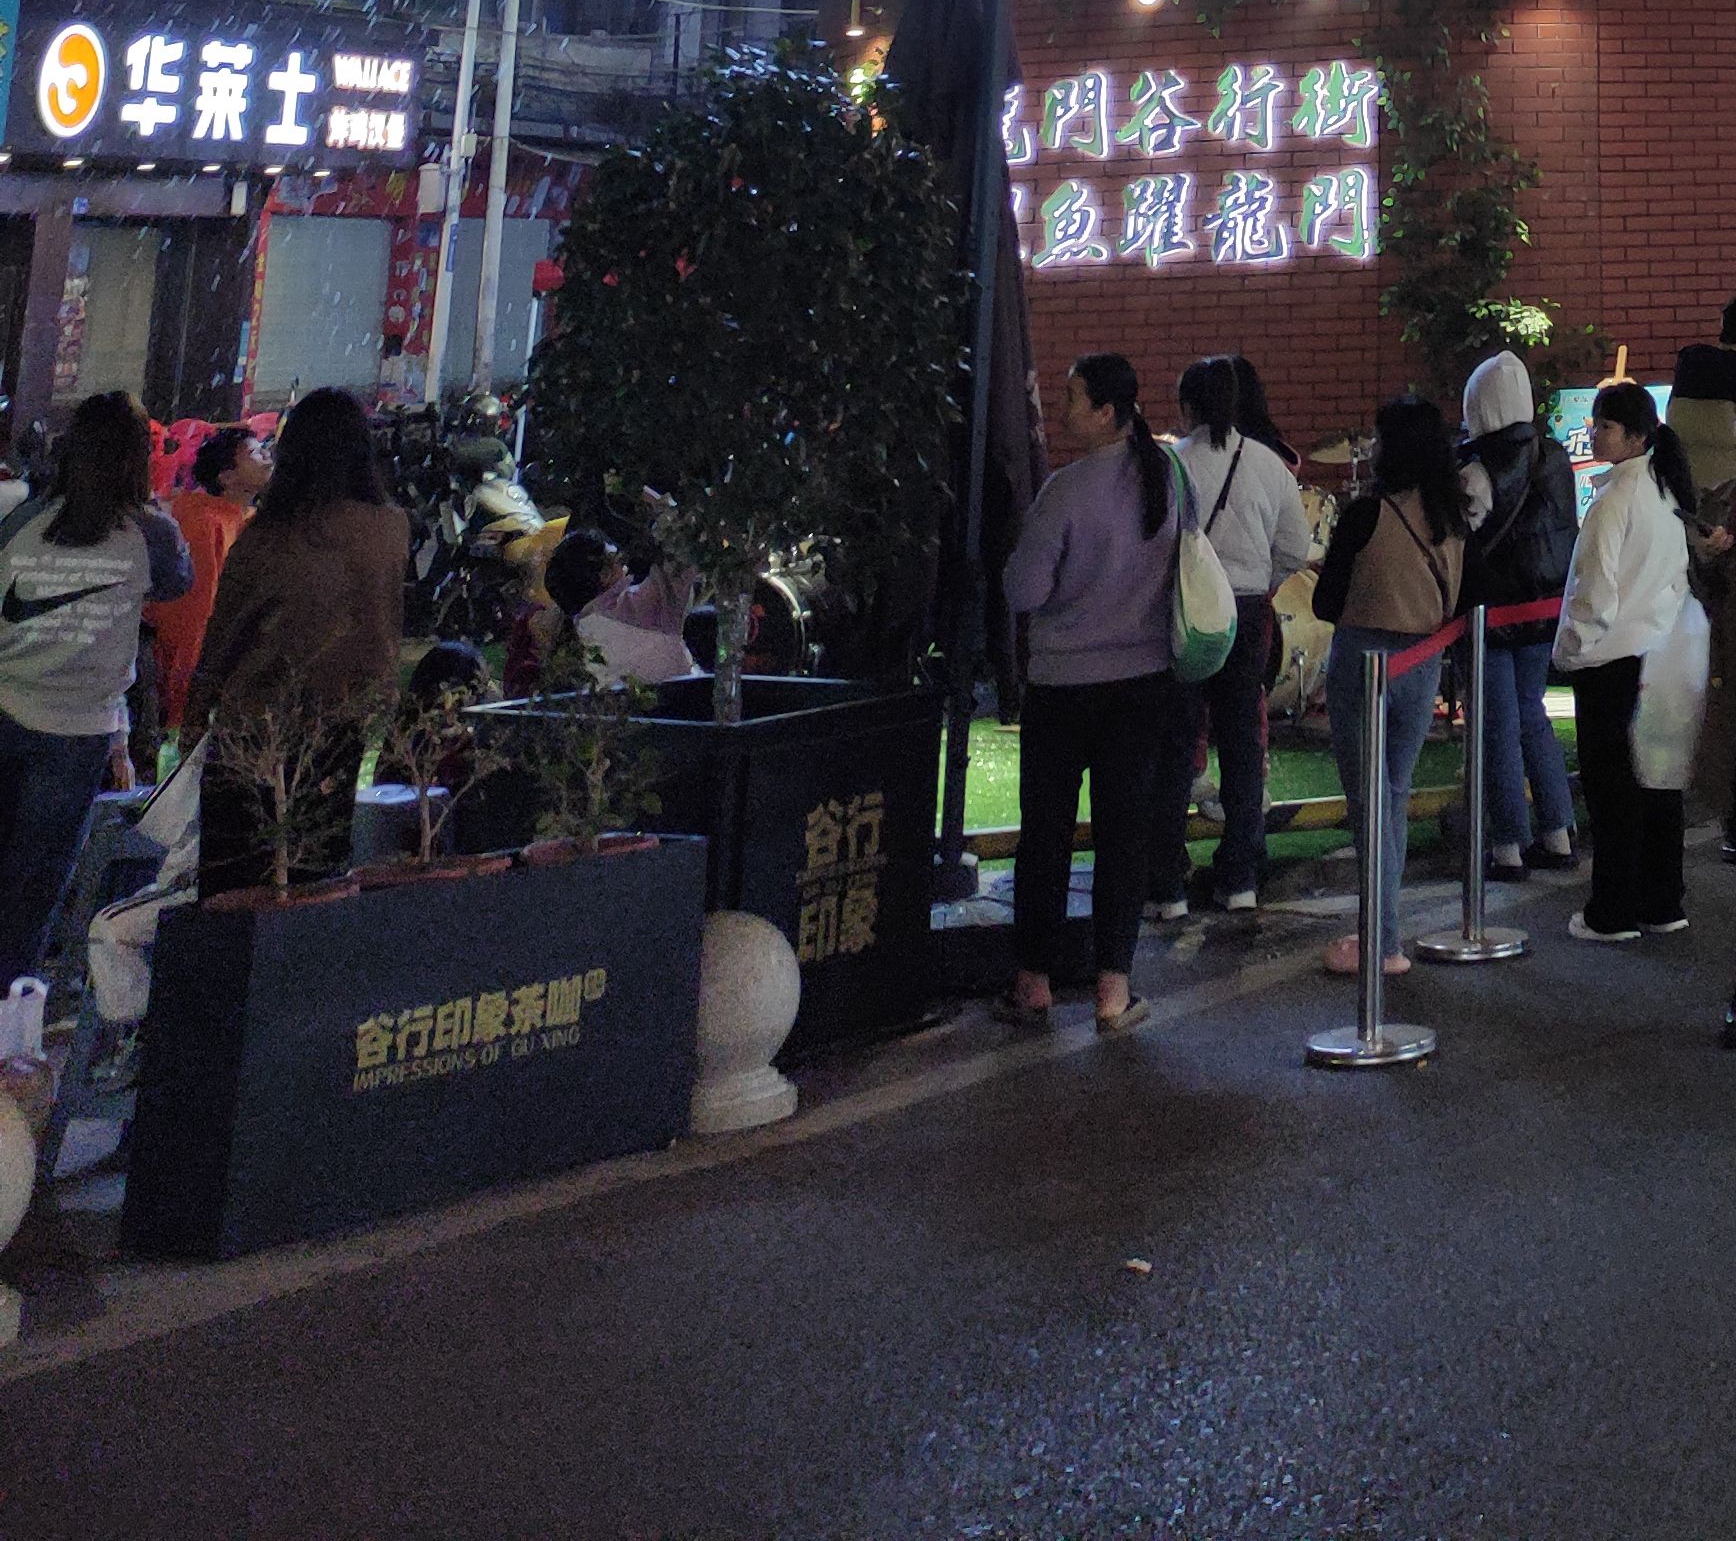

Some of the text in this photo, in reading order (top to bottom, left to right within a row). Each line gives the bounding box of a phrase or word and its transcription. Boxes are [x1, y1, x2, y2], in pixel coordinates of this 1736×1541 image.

[120, 33, 318, 147] 华莱士
[333, 53, 413, 94] WALLACE
[1009, 167, 1383, 268] 魚躍龍門
[804, 791, 885, 869] 谷行
[797, 877, 878, 963] 印象
[355, 973, 583, 1069] 谷行印象茶咖
